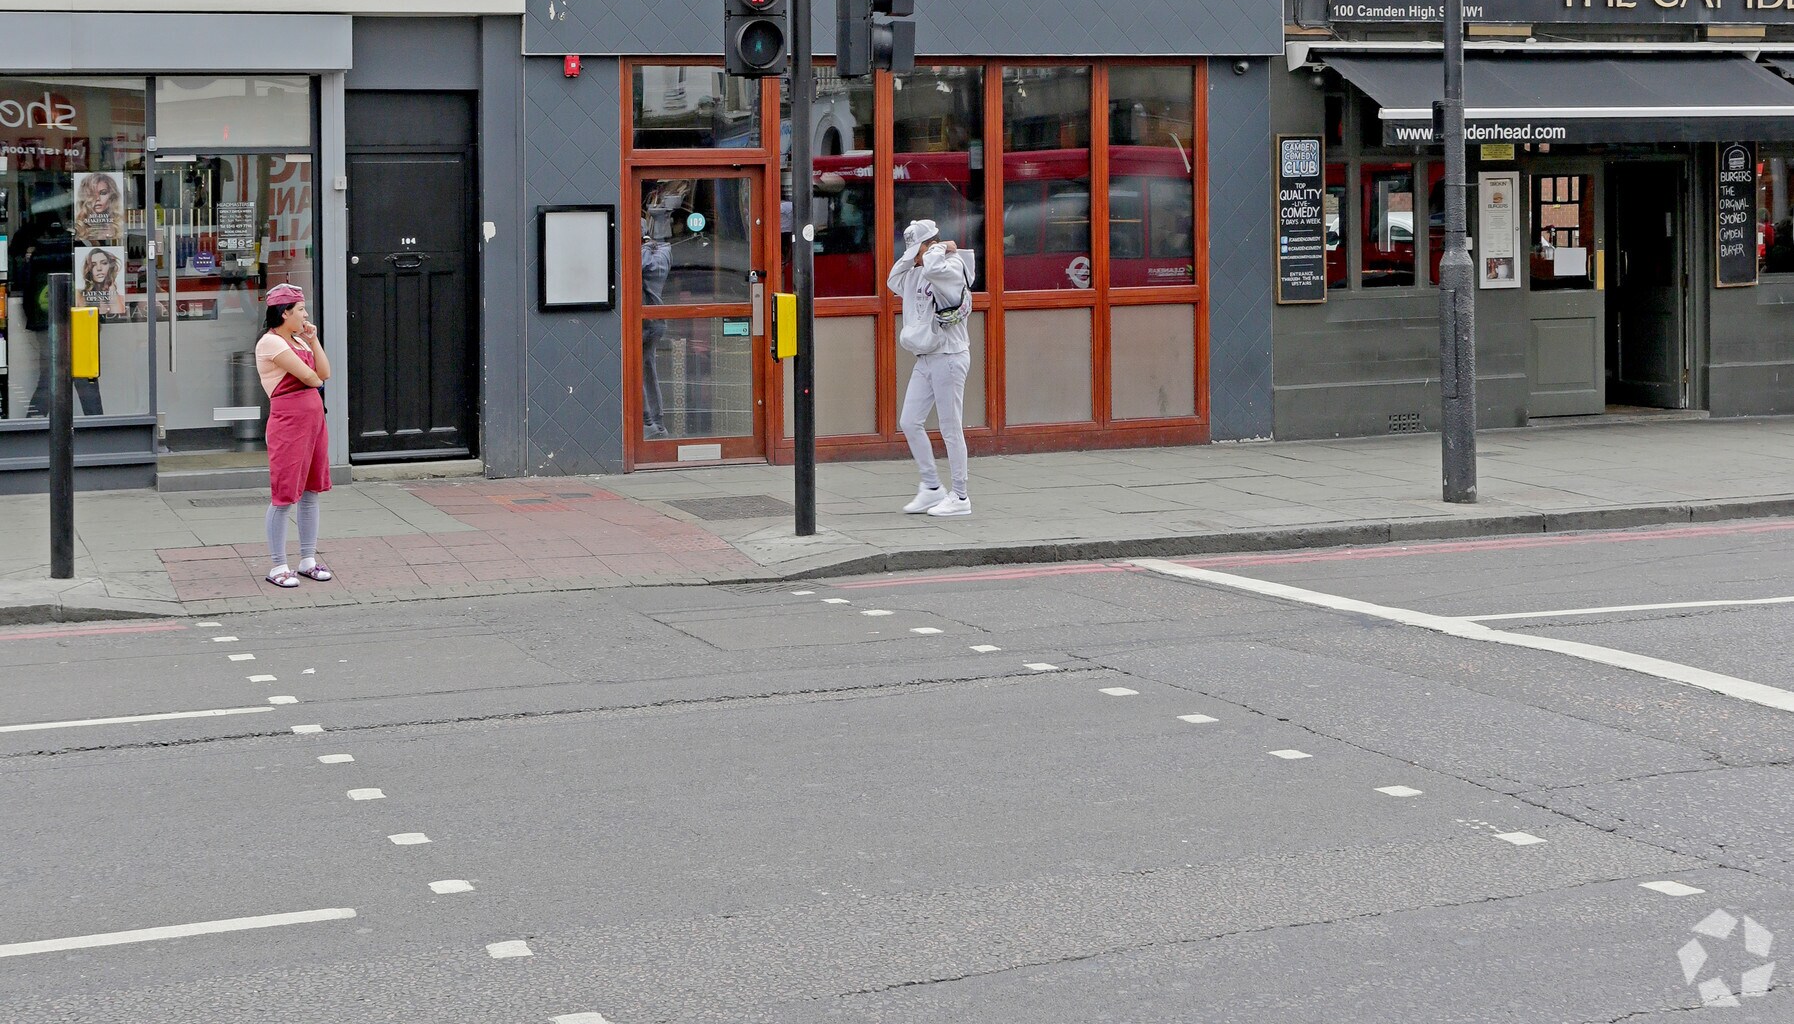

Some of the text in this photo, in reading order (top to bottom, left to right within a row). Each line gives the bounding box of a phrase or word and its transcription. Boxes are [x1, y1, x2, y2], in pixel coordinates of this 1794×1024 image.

[1333, 5, 1354, 17] 100
[1357, 5, 1406, 17] Camden
[1408, 5, 1435, 20] High
[1396, 123, 1566, 141] wwwdenhead.com
[1284, 142, 1317, 152] CAMDEN
[1284, 152, 1317, 160] COMEDY
[1284, 161, 1317, 174] CLUB
[1720, 170, 1752, 182] BURGERS
[1280, 188, 1322, 201] QUALITY
[1720, 185, 1735, 197] THE
[1281, 207, 1320, 218] COMEDY
[1719, 211, 1747, 225] SMOKED
[689, 218, 703, 227] 102
[1719, 226, 1744, 242] CAMDEN
[401, 237, 416, 245] 104
[1720, 243, 1746, 258] BURGER
